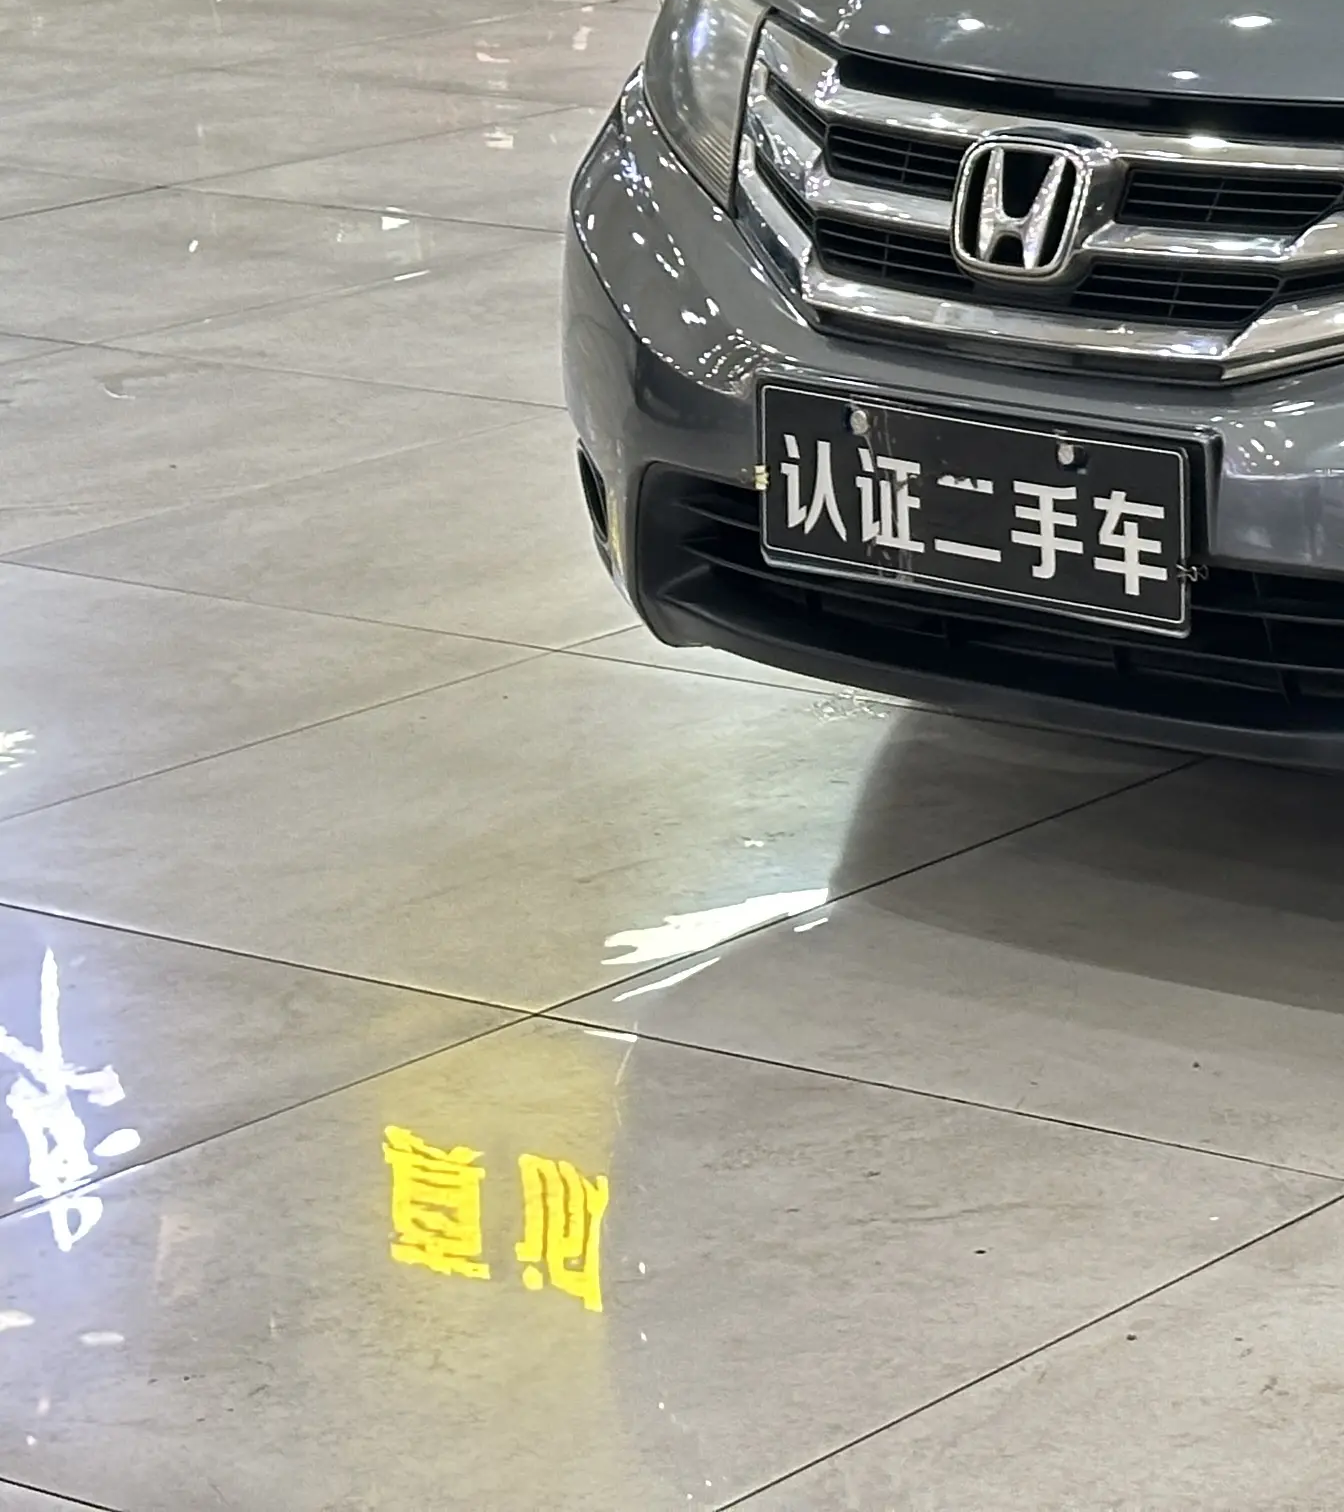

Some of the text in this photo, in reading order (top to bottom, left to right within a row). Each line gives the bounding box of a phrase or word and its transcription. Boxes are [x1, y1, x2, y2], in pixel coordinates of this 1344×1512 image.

[780, 434, 1169, 595] 认证二手车
